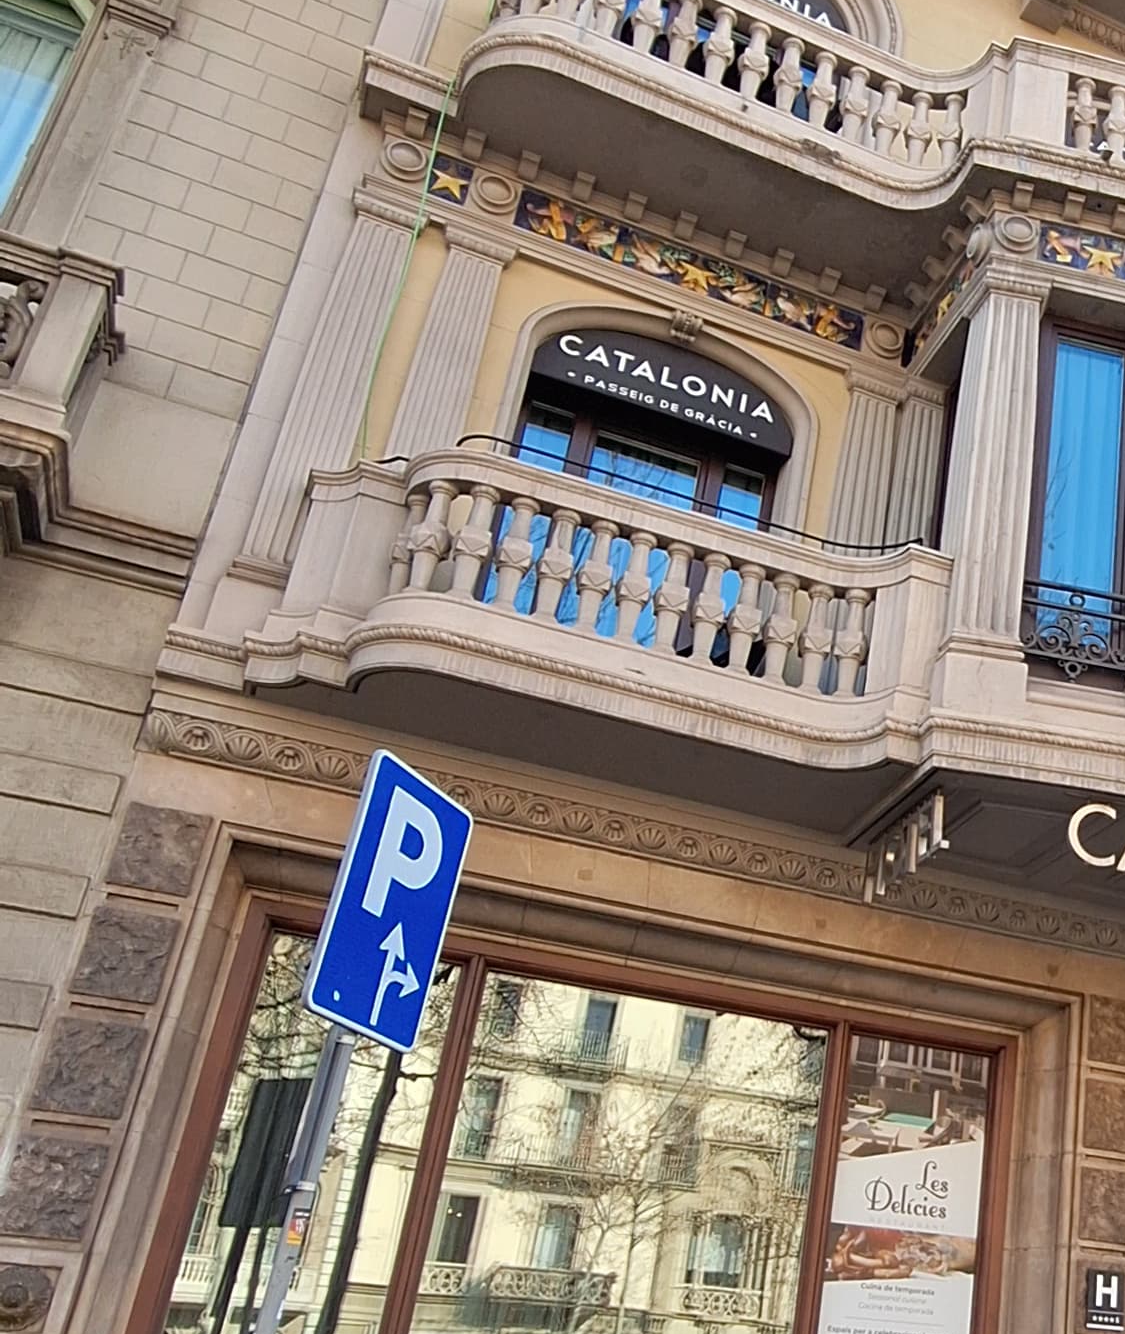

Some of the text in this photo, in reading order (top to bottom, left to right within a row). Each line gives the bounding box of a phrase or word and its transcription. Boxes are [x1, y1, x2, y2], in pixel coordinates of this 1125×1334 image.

[559, 334, 774, 423] CATALONIA
[584, 374, 743, 436] PASSEIG DE GRÀCIA
[361, 785, 443, 918] P
[864, 1176, 947, 1219] Delícies
[915, 1160, 949, 1199] Les
[860, 1282, 935, 1297] Cuina de temporada
[1096, 1274, 1118, 1308] H
[827, 1324, 851, 1334] Espais
